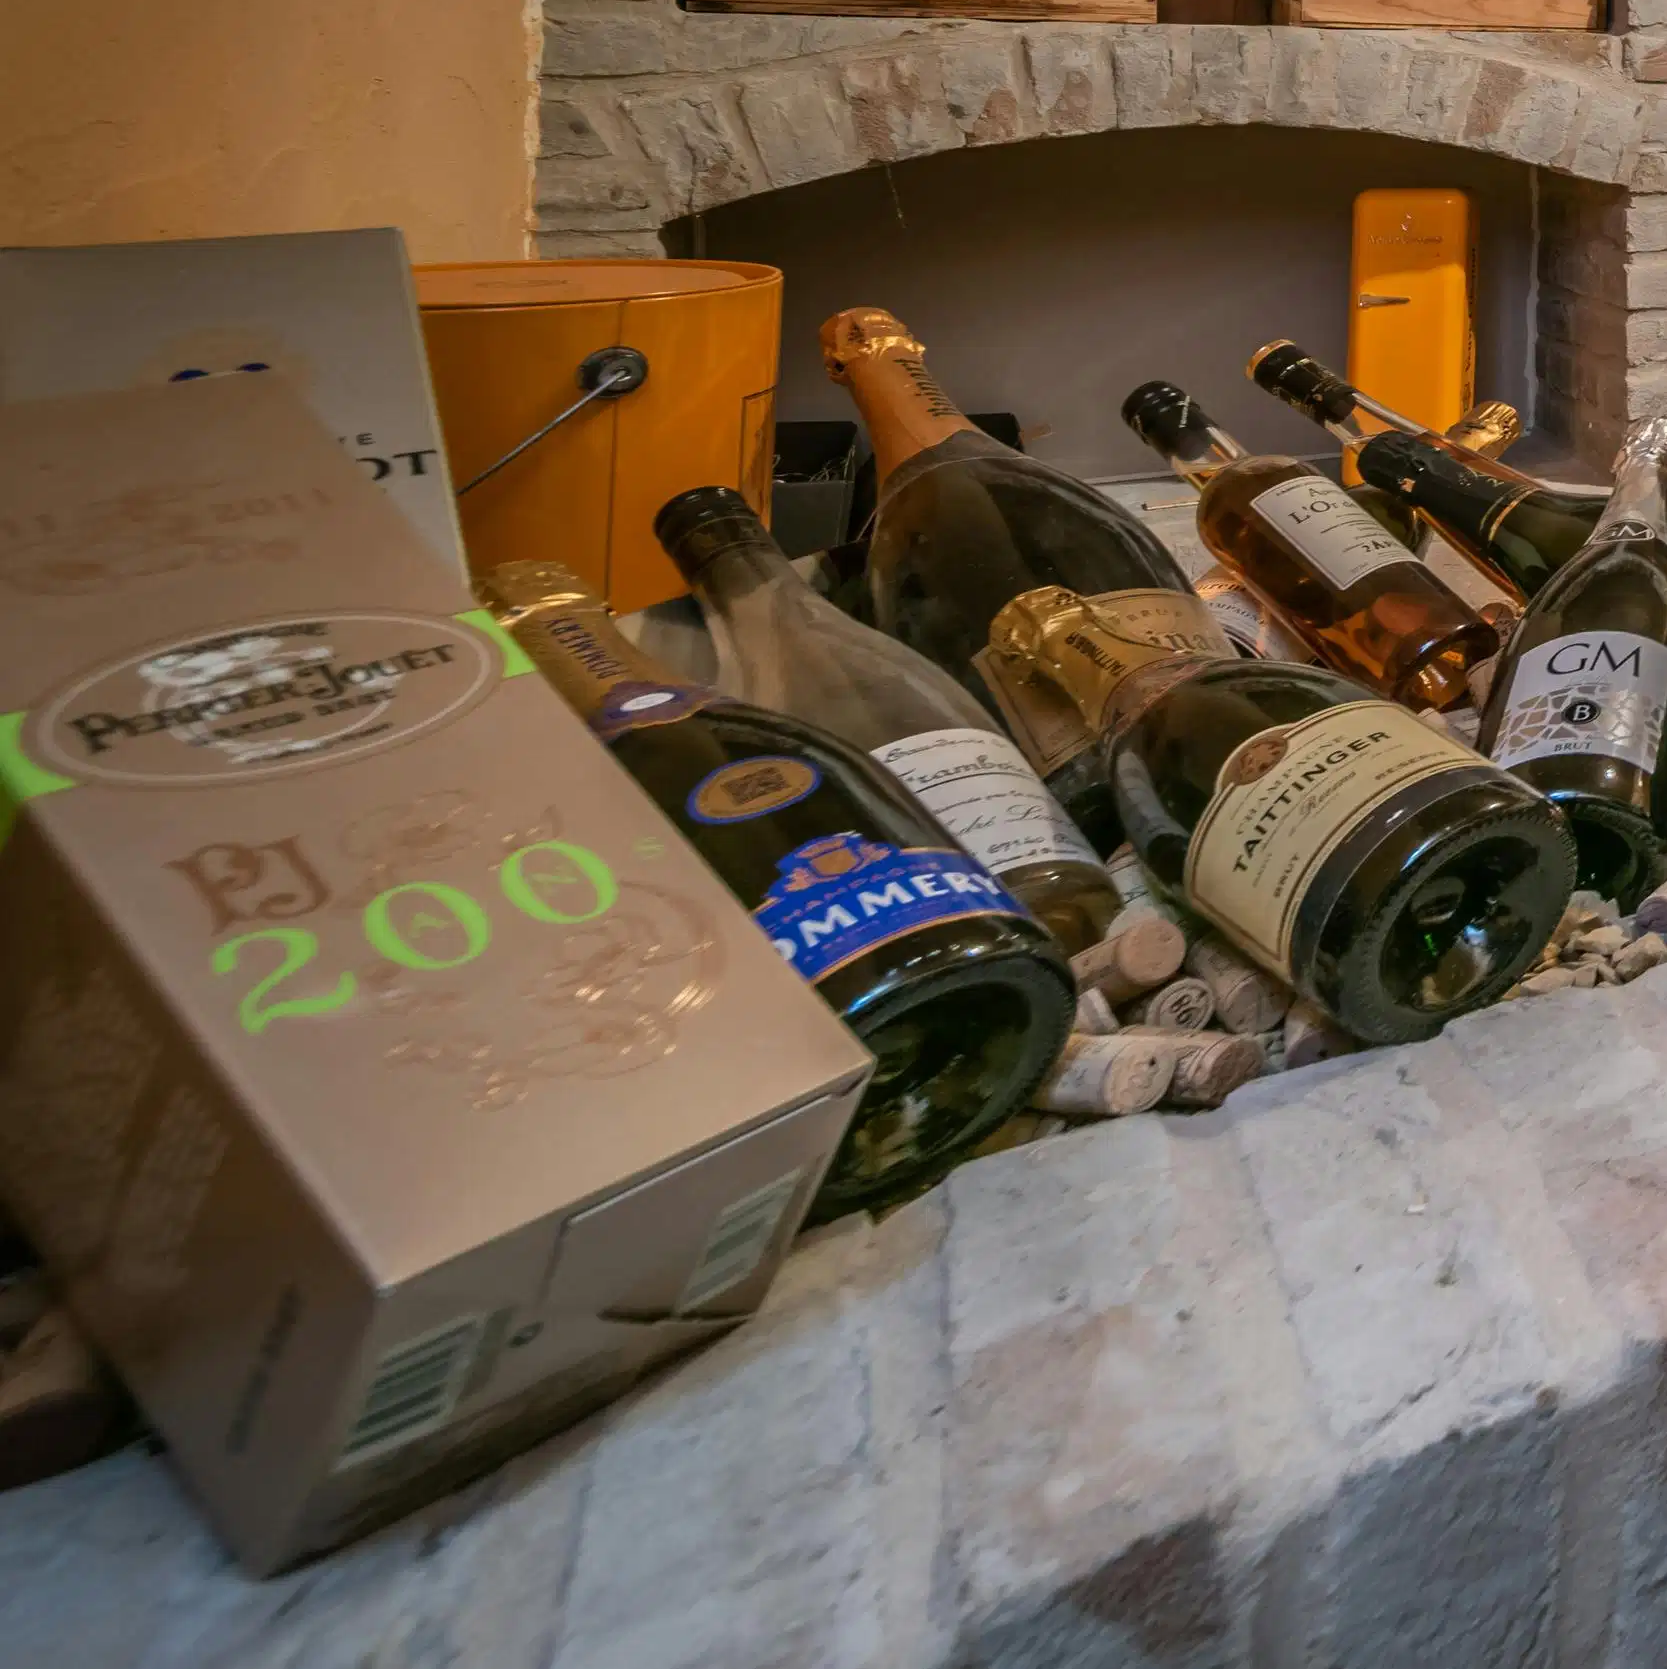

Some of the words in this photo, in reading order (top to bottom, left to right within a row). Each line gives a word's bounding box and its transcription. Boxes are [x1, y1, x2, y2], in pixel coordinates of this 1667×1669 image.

[1546, 641, 1641, 678] GM
[1573, 703, 1592, 722] B
[1554, 740, 1592, 752] BRUT
[1232, 730, 1392, 875] TAITTINGER
[772, 870, 1003, 963] OMMERY
